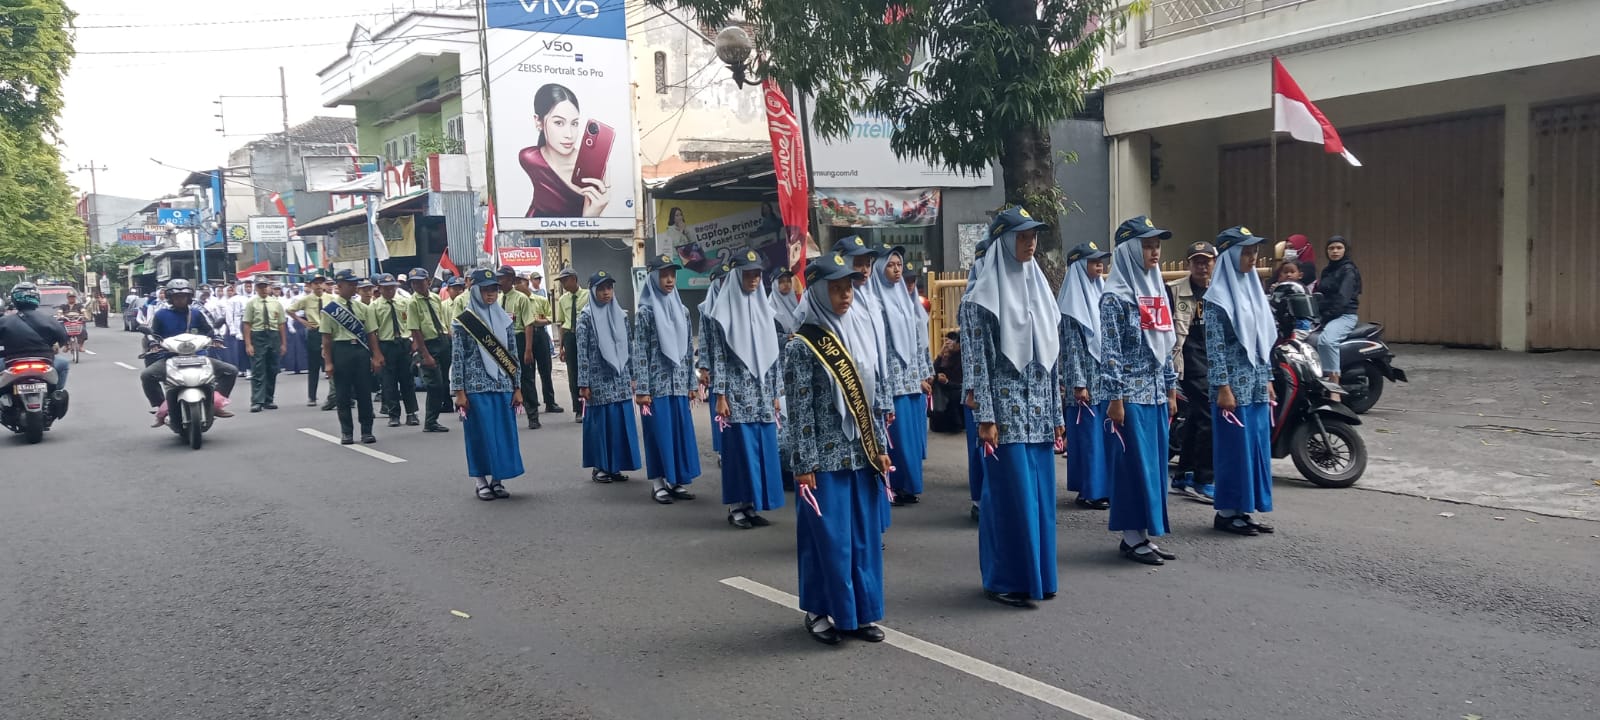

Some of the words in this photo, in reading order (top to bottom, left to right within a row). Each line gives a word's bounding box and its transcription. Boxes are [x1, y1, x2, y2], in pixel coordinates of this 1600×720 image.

[542, 40, 573, 52] V50
[518, 63, 543, 73] ZEISS
[544, 65, 576, 76] Portrait
[577, 67, 589, 76] So
[590, 67, 604, 78] Pro
[540, 219, 567, 228] DAN
[569, 219, 600, 228] CELL
[732, 218, 763, 232] Printer
[503, 250, 538, 258] DANCELL
[331, 306, 359, 332] SMPN
[817, 335, 840, 357] SMP
[834, 357, 870, 431] MUHAMMADIYAH
